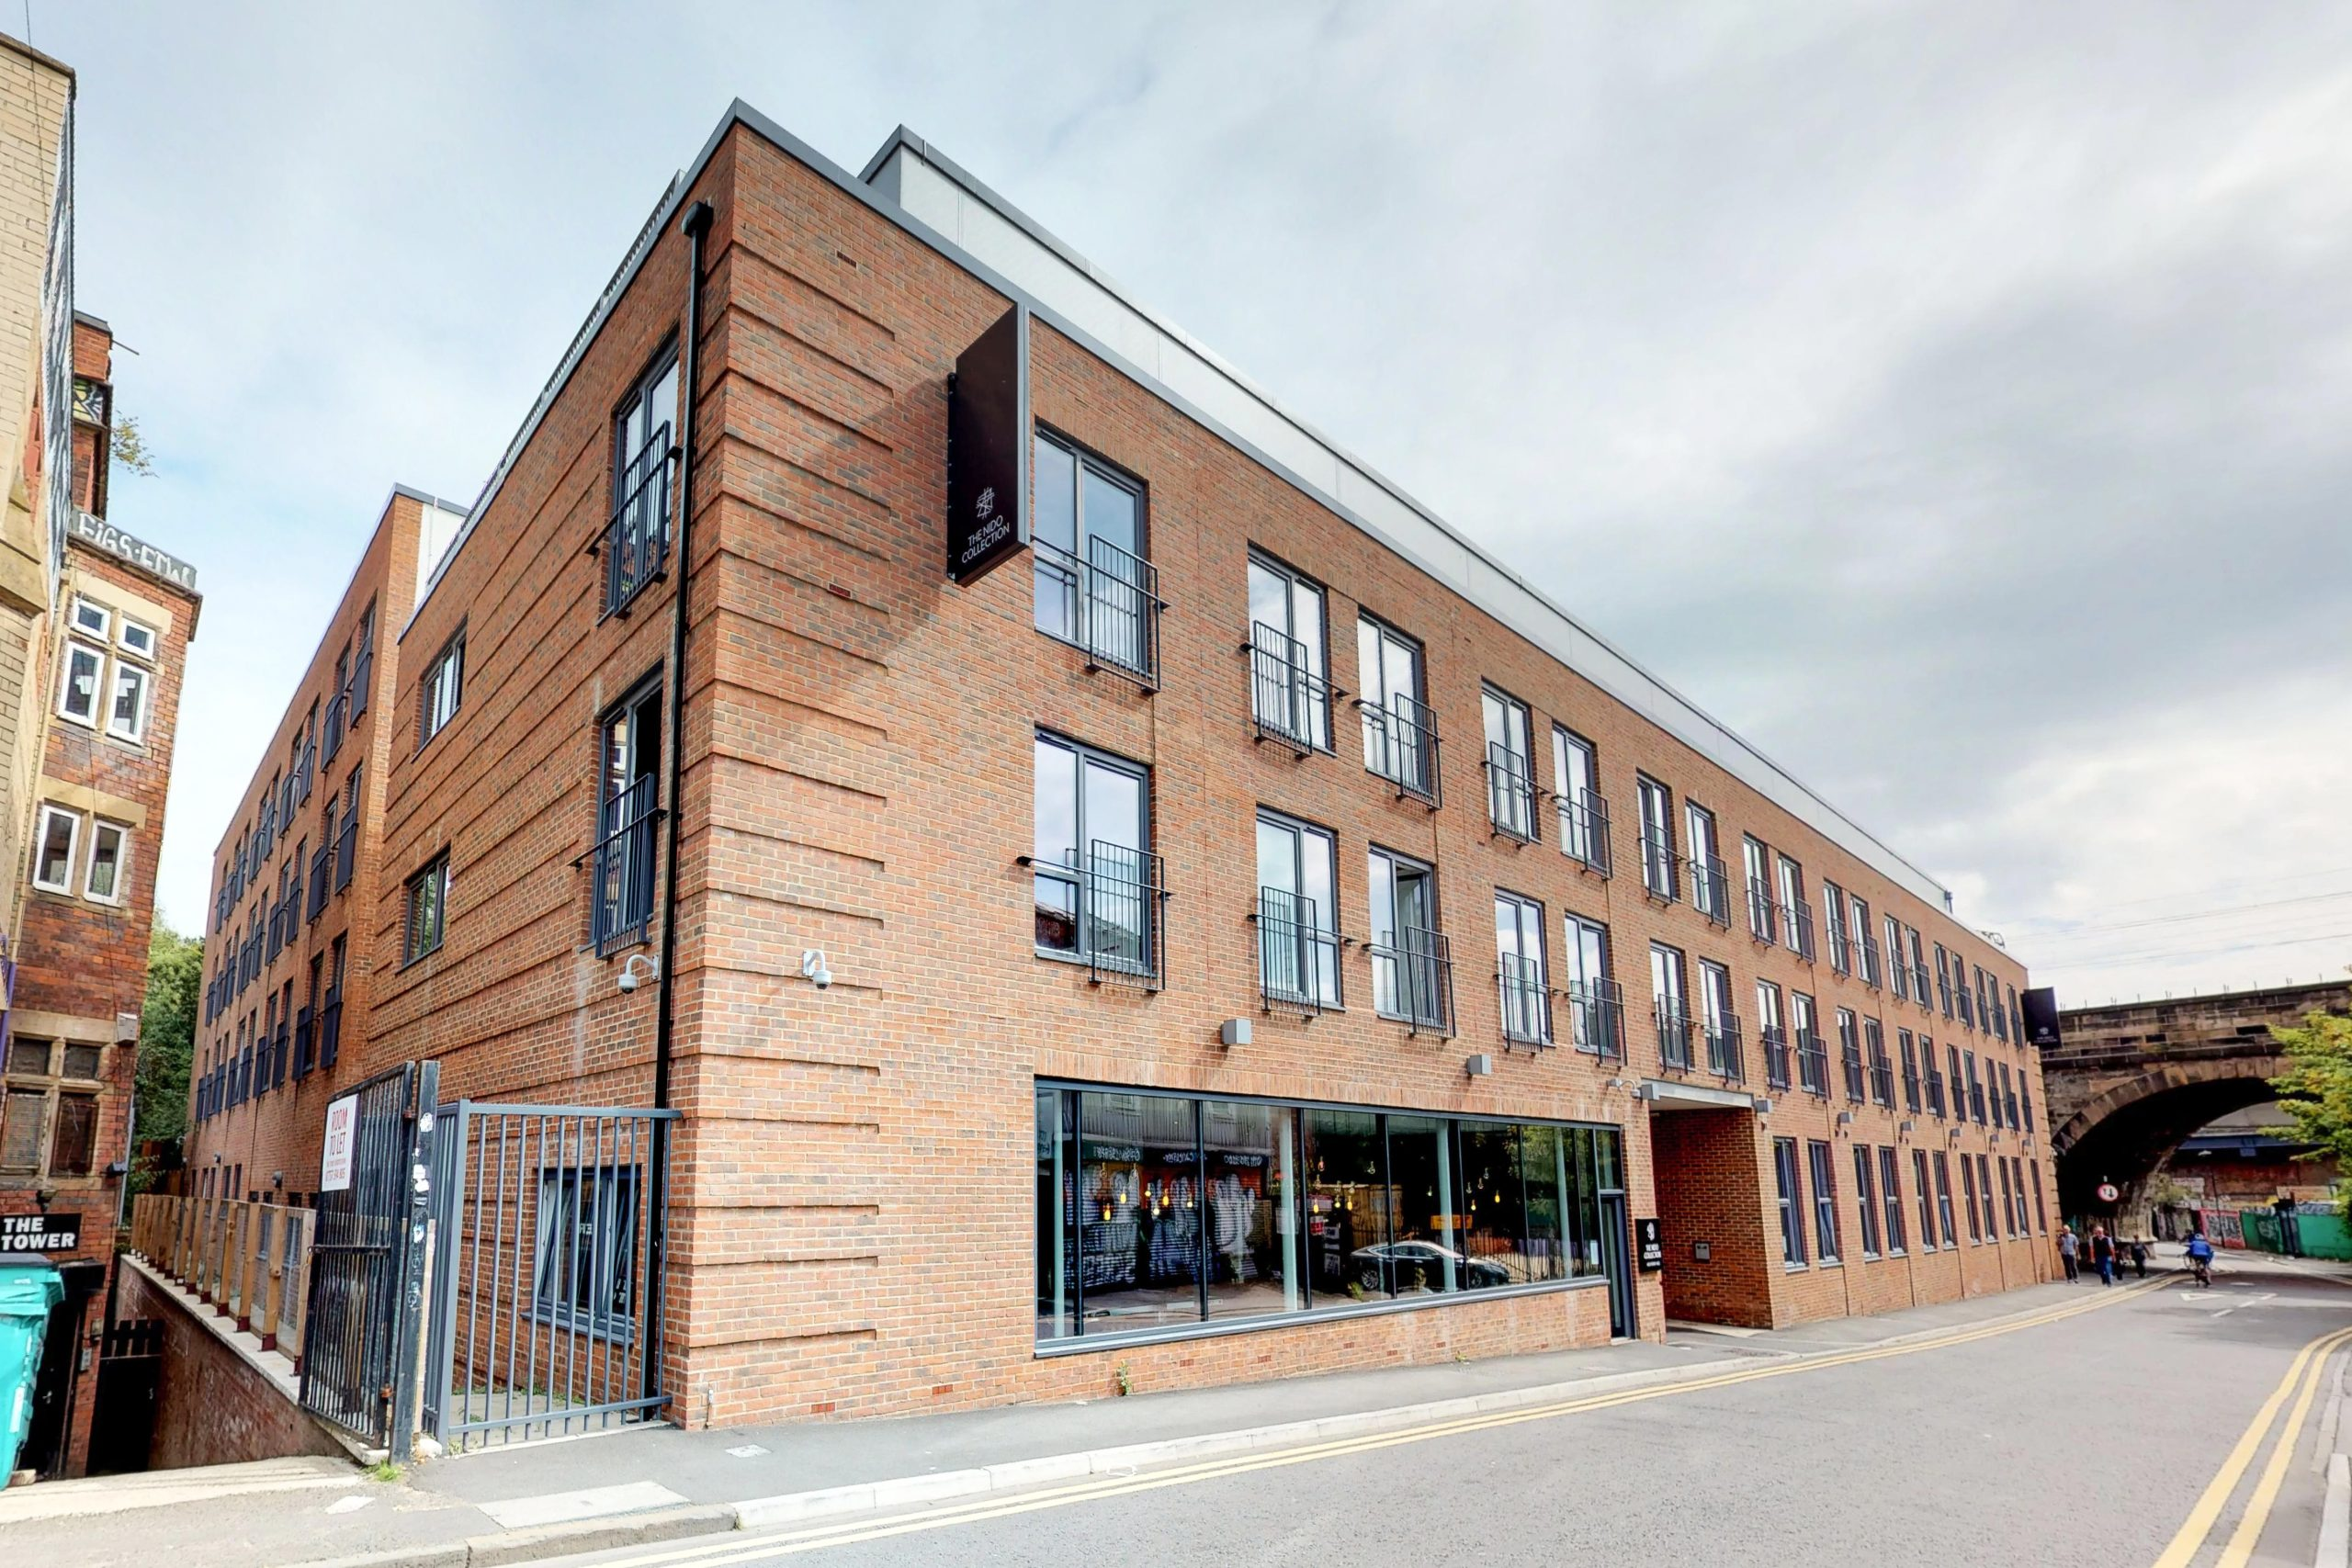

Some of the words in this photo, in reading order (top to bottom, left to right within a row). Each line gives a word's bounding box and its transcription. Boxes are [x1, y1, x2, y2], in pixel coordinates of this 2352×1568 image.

[962, 522, 1010, 563] COLLECTION
[967, 529, 982, 547] THE
[983, 515, 1003, 536] NIDO
[336, 1132, 345, 1155] LET
[4, 1217, 44, 1233] THE
[1, 1232, 75, 1251] TOWER
